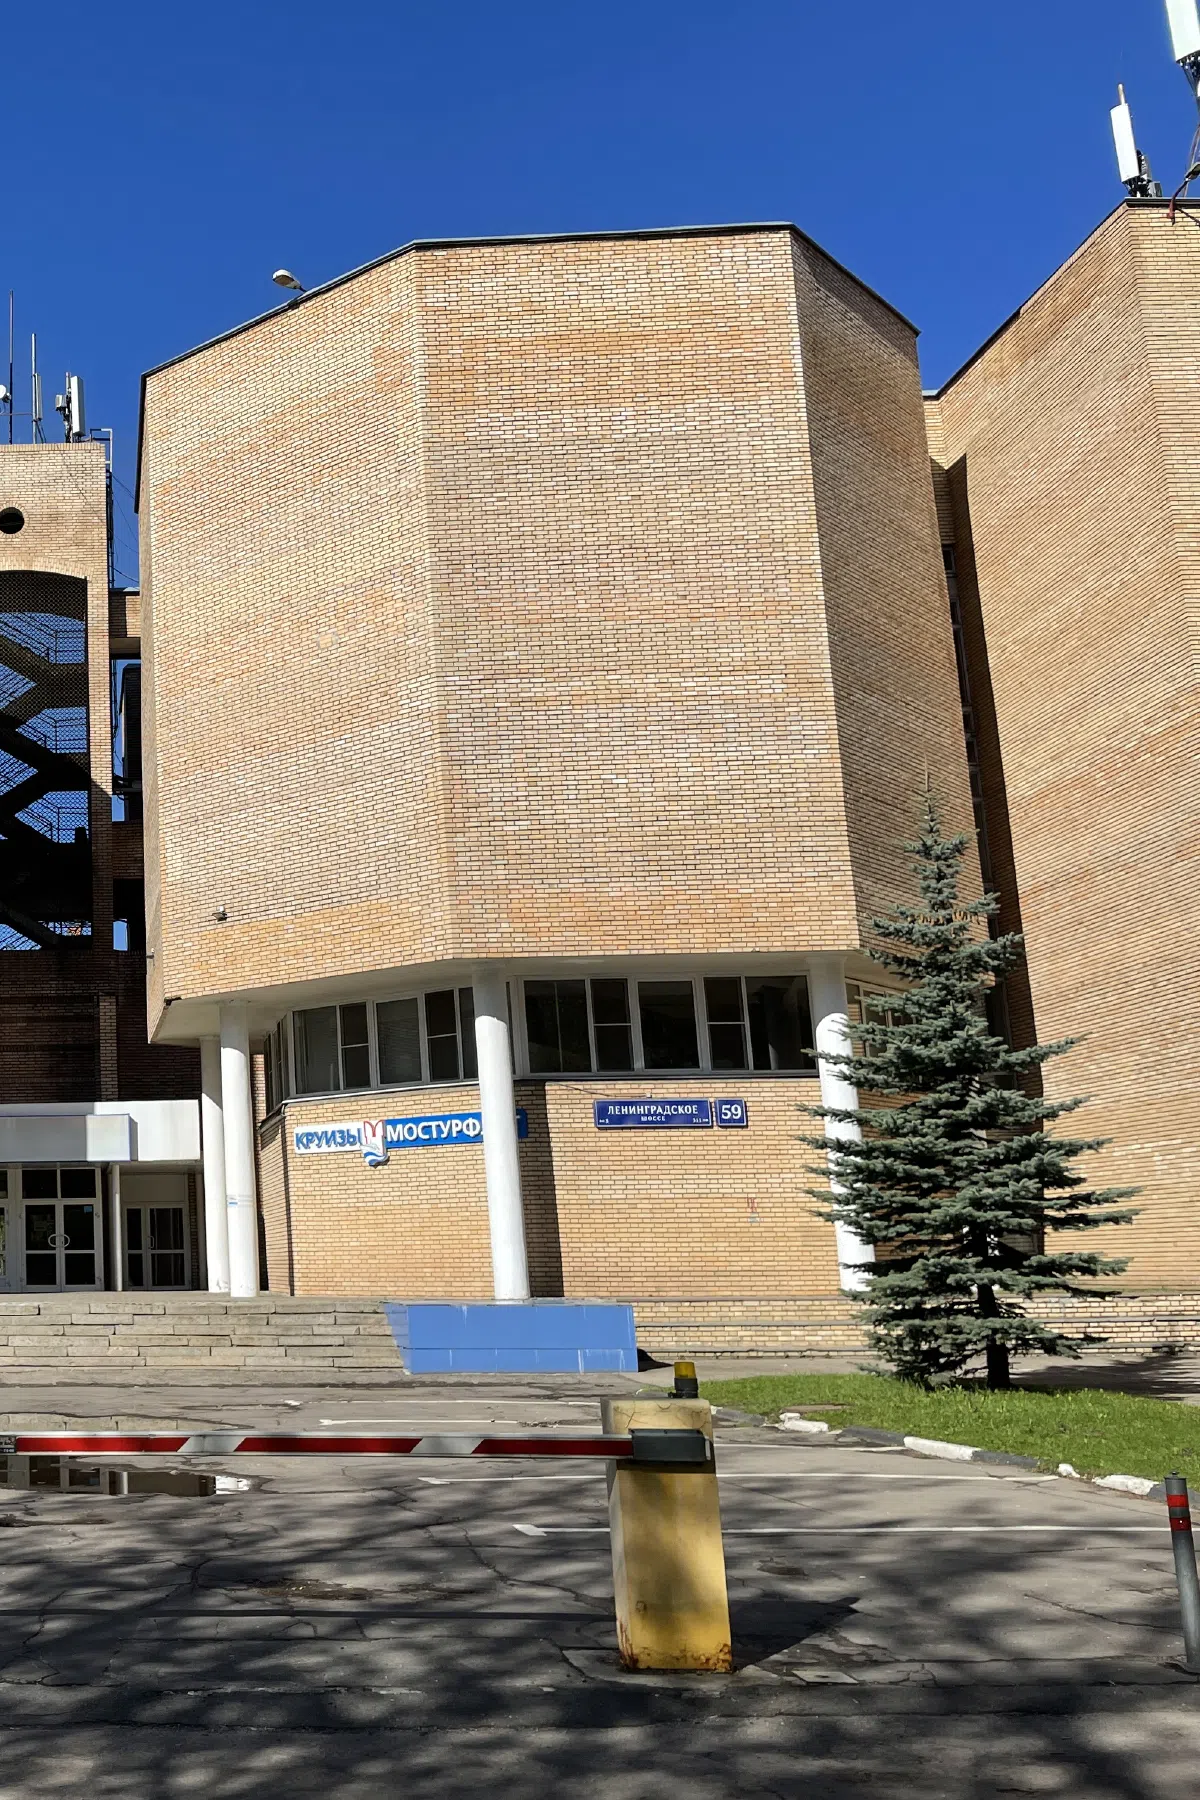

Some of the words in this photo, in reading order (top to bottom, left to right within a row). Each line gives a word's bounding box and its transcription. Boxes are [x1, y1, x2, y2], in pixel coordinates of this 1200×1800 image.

[607, 1105, 698, 1115] ЛЕНИНГРАДСКОЕ
[721, 1104, 742, 1120] 59
[295, 1127, 362, 1149] КРУИЗЫ
[387, 1115, 520, 1142] МОСТУРФ
